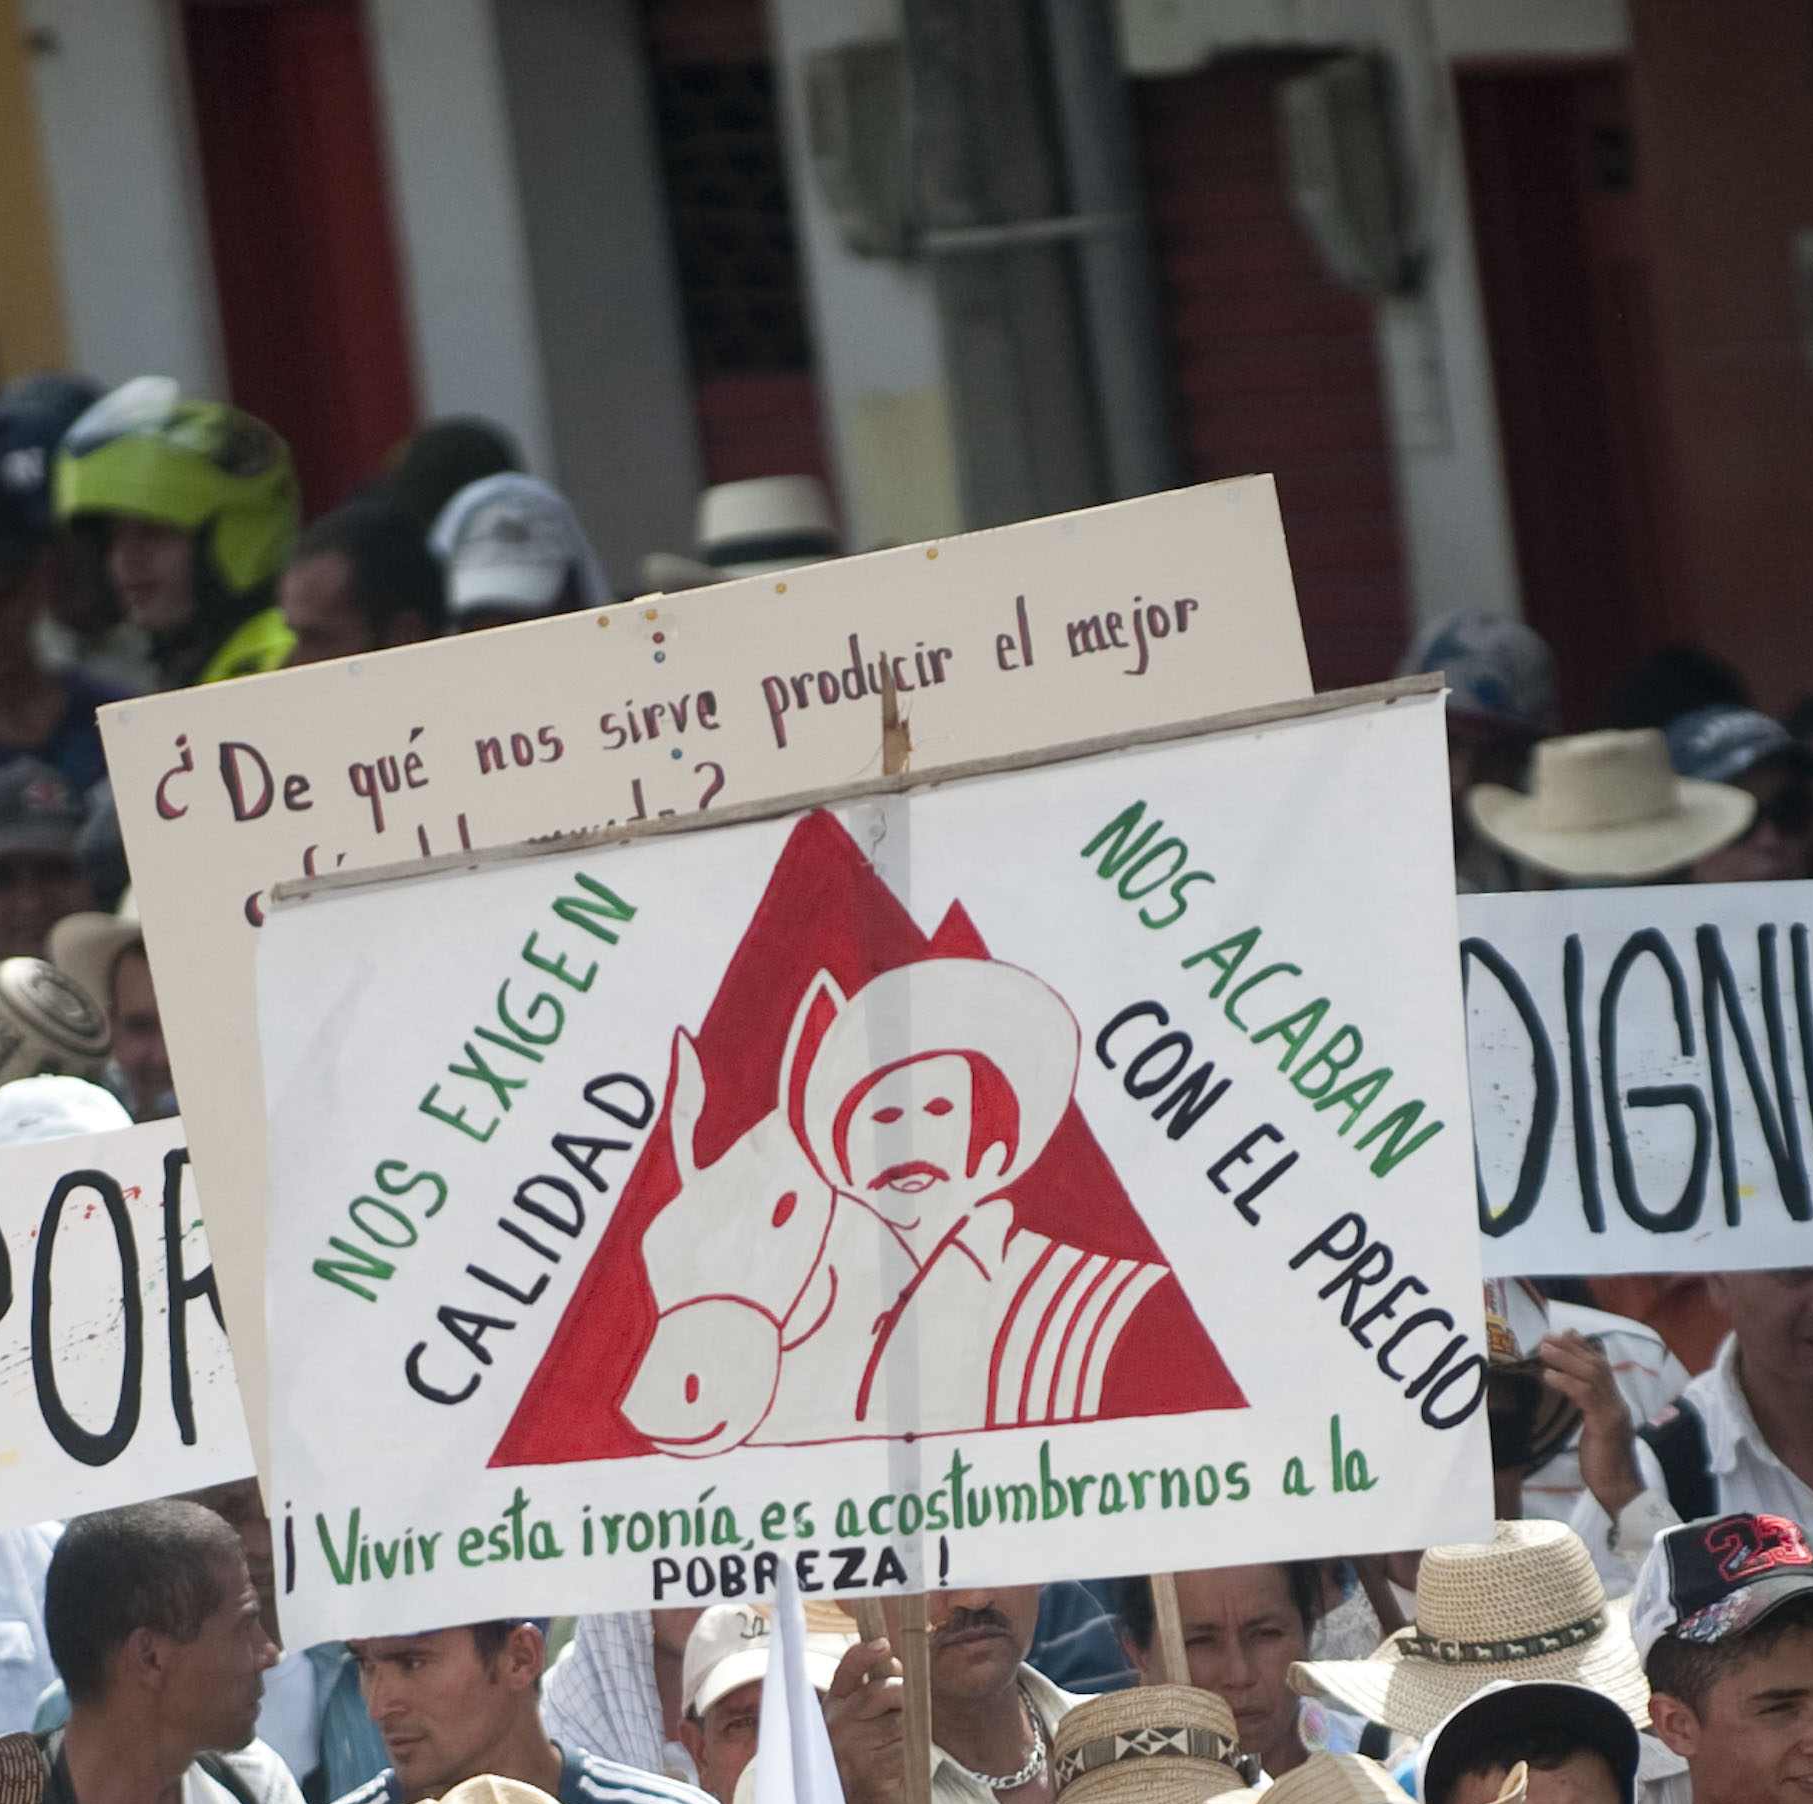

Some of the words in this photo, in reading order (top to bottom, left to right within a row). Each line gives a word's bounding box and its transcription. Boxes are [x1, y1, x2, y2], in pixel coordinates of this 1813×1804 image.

[349, 725, 426, 834] qué
[475, 729, 566, 776] nos
[601, 690, 719, 746] sirve
[763, 638, 952, 749] producir
[997, 599, 1032, 673] el
[1067, 591, 1199, 676] mejor
[314, 1159, 449, 1301] NOS
[420, 874, 638, 1144] EXIGEN
[1083, 802, 1214, 932] NOS
[1182, 927, 1442, 1180] ACABAN
[405, 1073, 655, 1406] CALIDAD
[1095, 1002, 1231, 1133] CON
[1210, 1141, 1296, 1226] EL
[1290, 1214, 1492, 1430] PRECIO
[458, 1486, 563, 1563] esta
[753, 1499, 815, 1540] es
[835, 1446, 1250, 1540] acostumbrarnos
[1283, 1460, 1315, 1497] a
[1330, 1418, 1378, 1495] la
